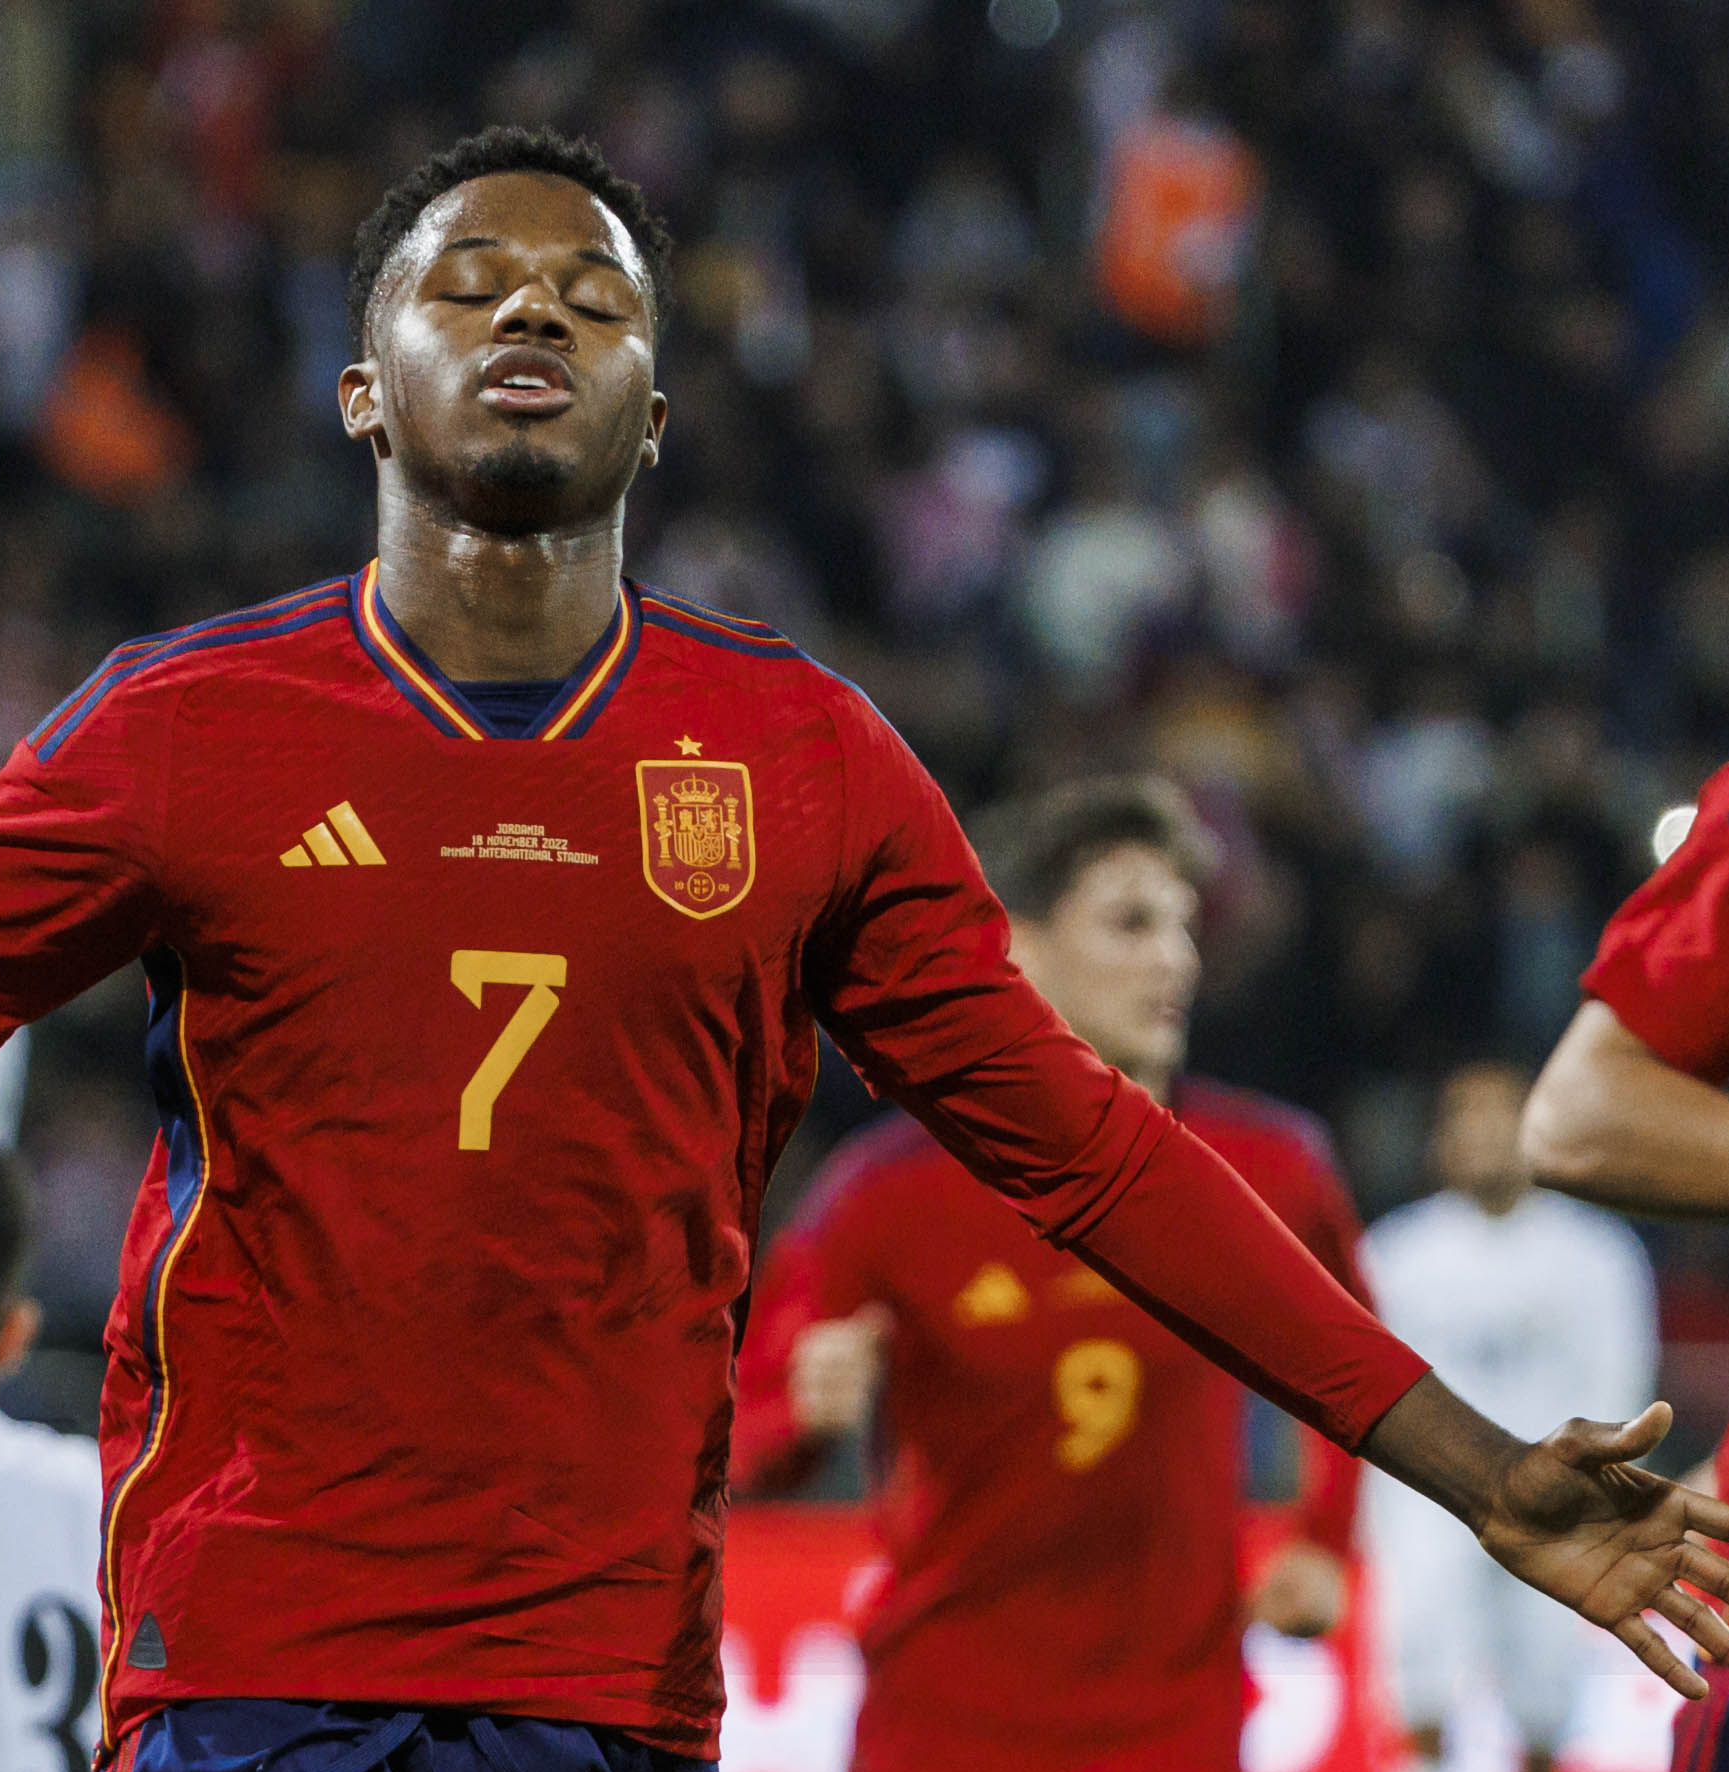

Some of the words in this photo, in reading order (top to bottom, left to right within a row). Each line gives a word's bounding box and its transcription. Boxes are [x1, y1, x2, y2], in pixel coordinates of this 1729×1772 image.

[496, 823, 545, 836] JORDANIA
[472, 835, 483, 846] 18
[487, 836, 538, 849] NOVEMBER
[542, 838, 569, 850] 2022
[440, 846, 474, 857] AMMAN
[478, 847, 553, 862] INTERNATIONAL
[557, 851, 599, 865] STADIUM
[451, 950, 567, 1150] 7
[1054, 1340, 1140, 1472] 9
